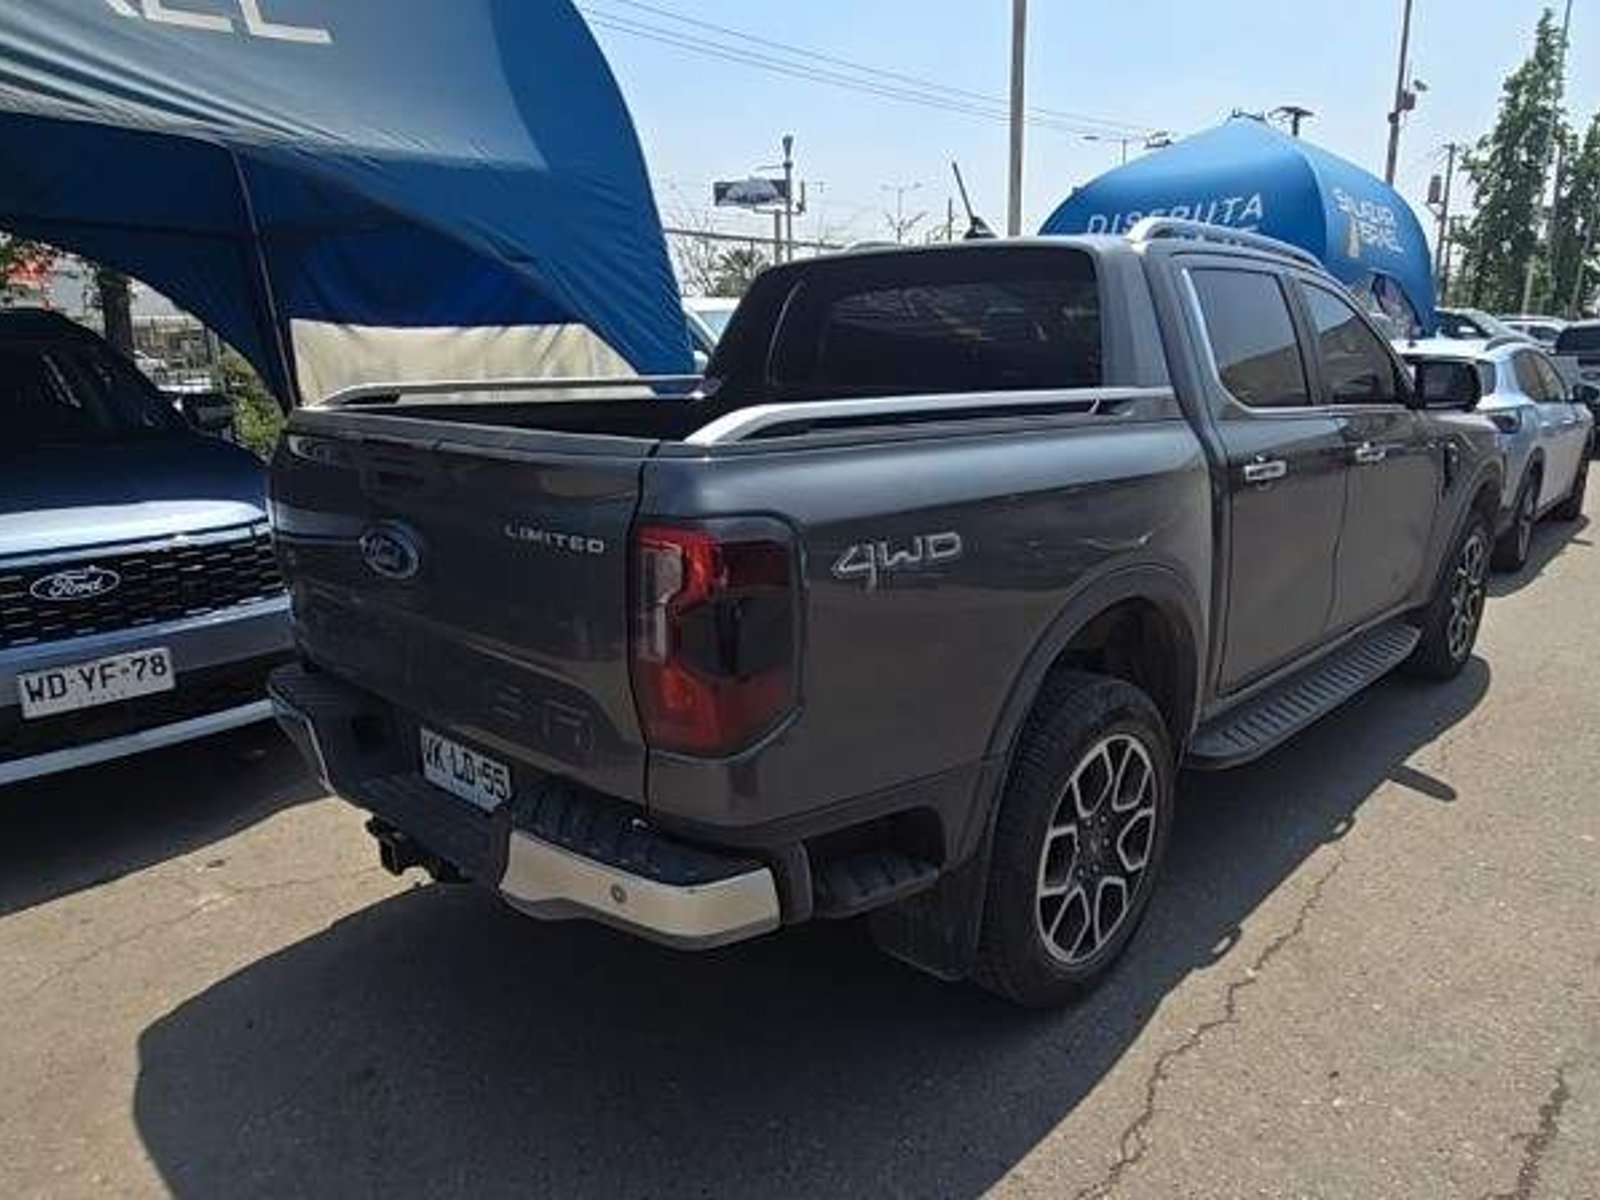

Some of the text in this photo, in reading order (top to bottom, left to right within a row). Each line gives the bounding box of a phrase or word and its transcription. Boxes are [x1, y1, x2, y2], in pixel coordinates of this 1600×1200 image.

[504, 524, 605, 553] LIMITED
[831, 531, 963, 593] 4WD
[49, 574, 104, 597] Ford
